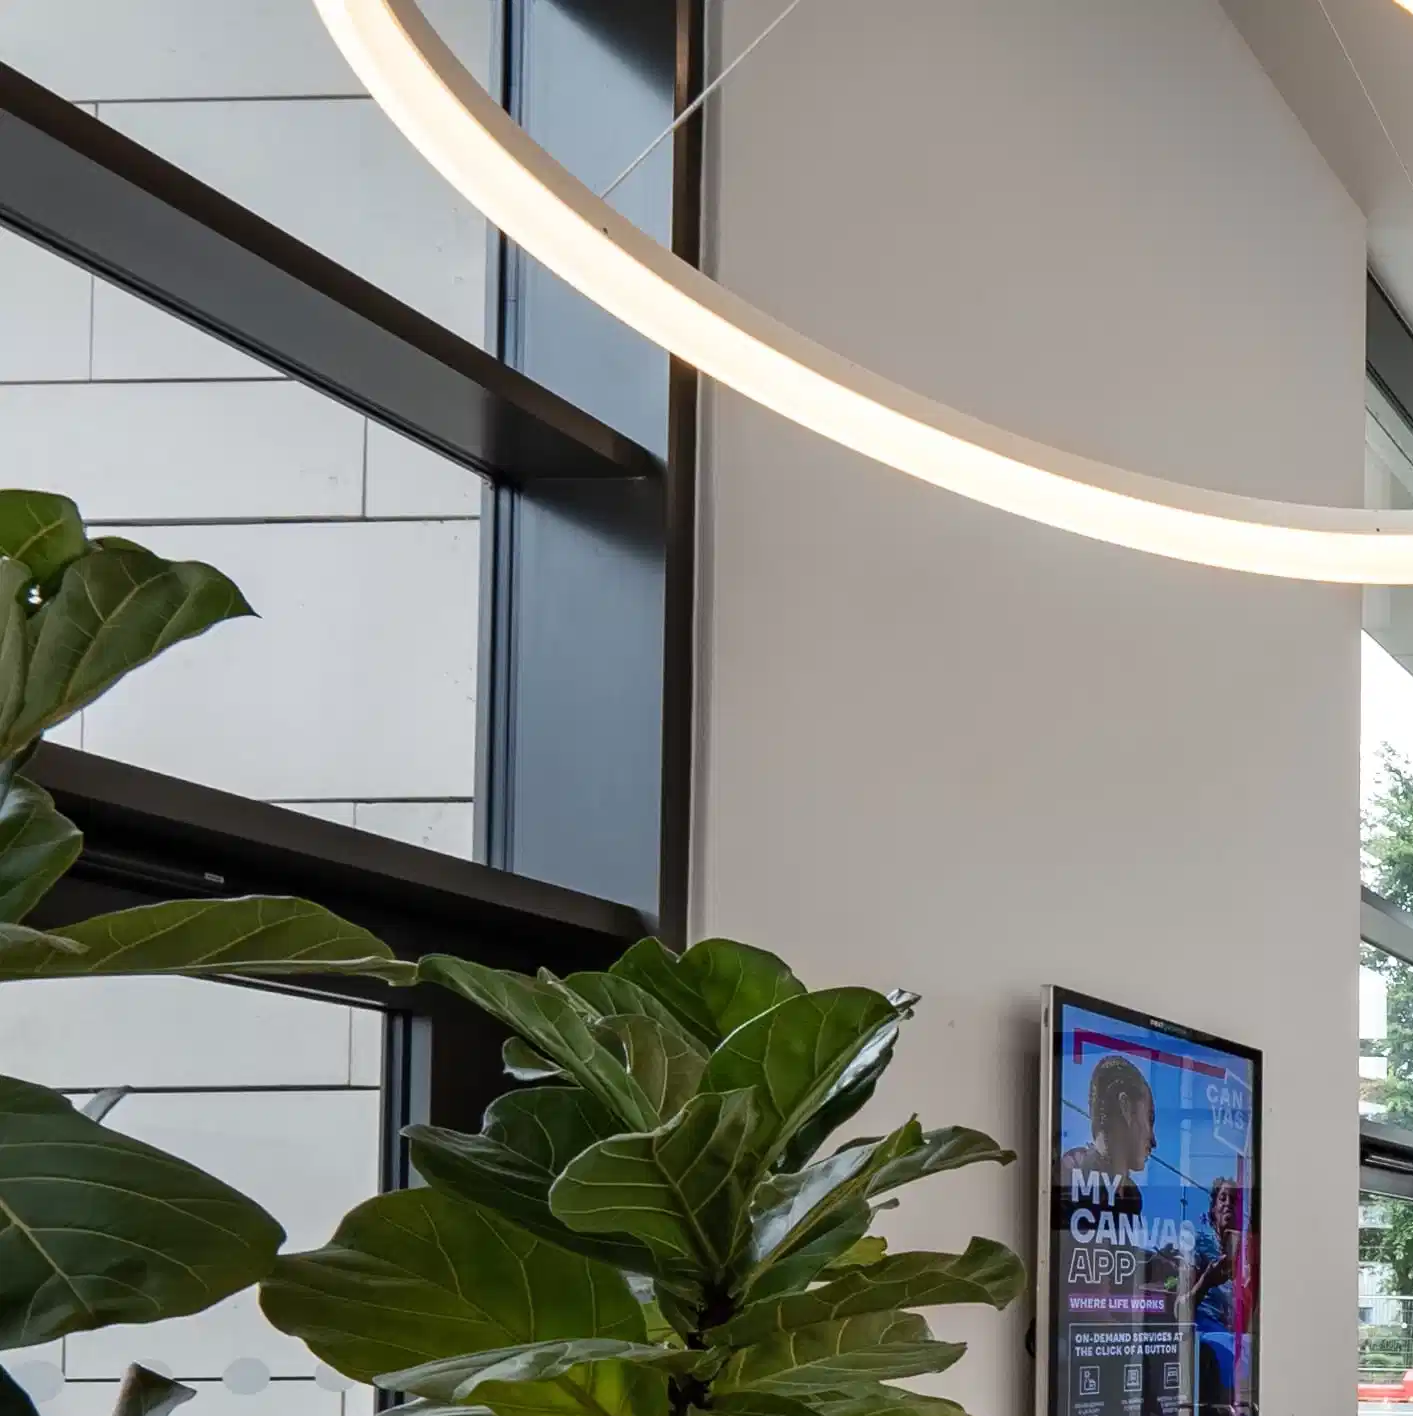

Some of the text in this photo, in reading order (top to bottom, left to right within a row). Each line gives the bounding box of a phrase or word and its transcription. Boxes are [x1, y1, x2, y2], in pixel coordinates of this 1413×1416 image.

[1206, 1084, 1243, 1108] CAN
[1212, 1104, 1244, 1130] VAS
[1071, 1168, 1123, 1207] MY
[1070, 1208, 1196, 1251] CANVAS
[1068, 1248, 1136, 1284] APP
[1070, 1297, 1165, 1310] WHERE LIFE WORKS
[1075, 1332, 1184, 1343] ON-DEMAND SERVICES AT
[1075, 1346, 1093, 1357] THE
[1095, 1346, 1122, 1356] CLICK
[1124, 1345, 1136, 1355] OF
[1144, 1344, 1178, 1355] BUTTON
